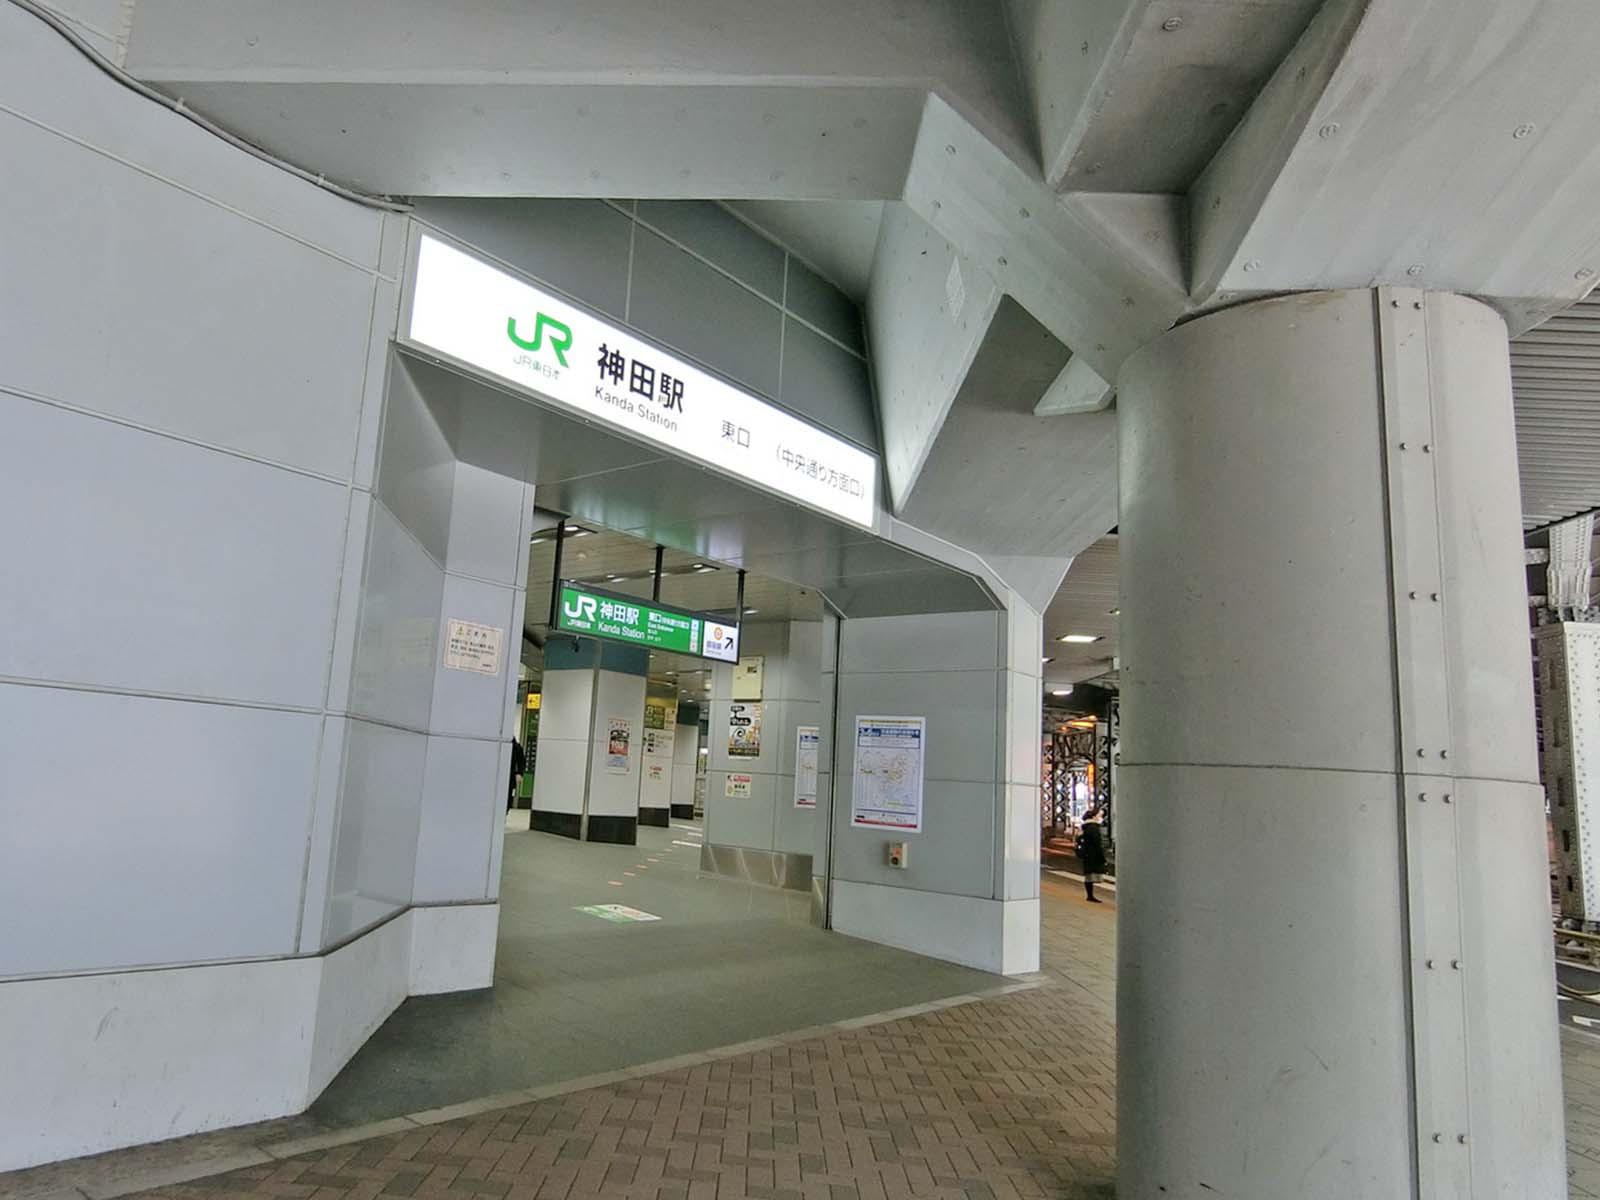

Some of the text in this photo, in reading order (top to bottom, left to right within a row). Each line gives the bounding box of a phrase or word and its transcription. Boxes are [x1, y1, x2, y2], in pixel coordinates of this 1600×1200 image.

[507, 312, 573, 368] JR
[597, 343, 685, 413] 神田駅
[595, 386, 678, 431] Kanda Station
[721, 420, 751, 448] 東口
[564, 595, 597, 622] JR
[600, 601, 640, 625] 神田駅
[598, 622, 621, 635] Kanda
[622, 626, 645, 639] Station
